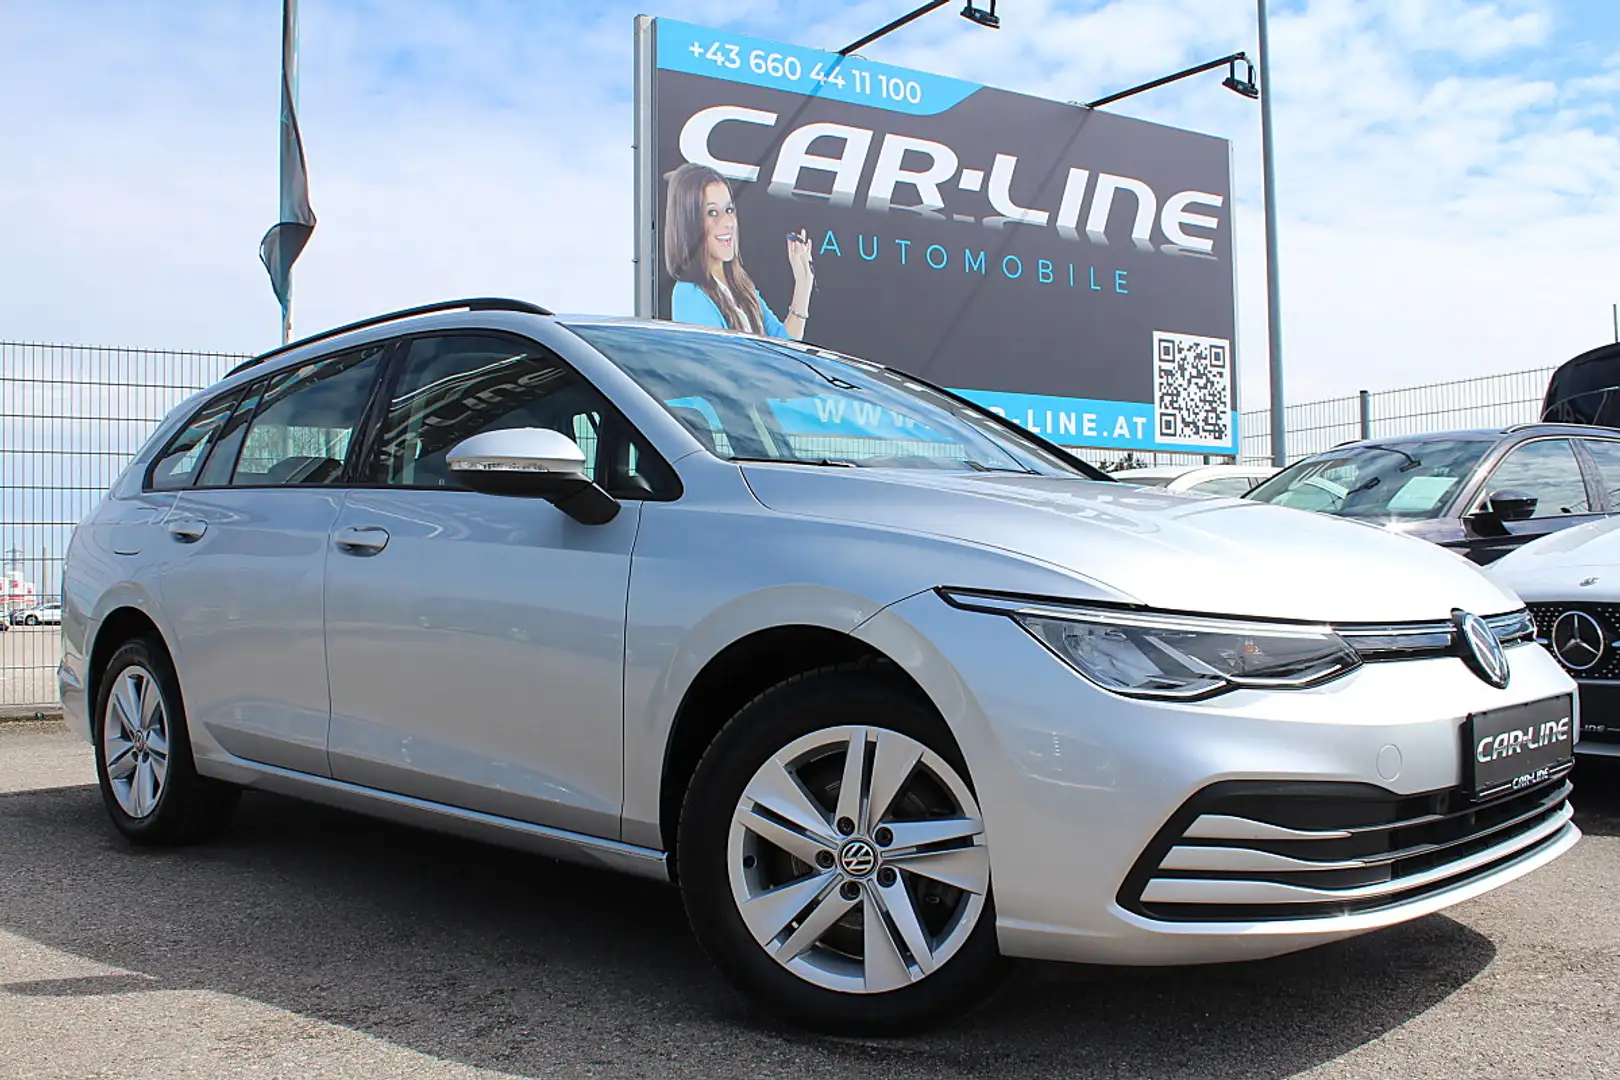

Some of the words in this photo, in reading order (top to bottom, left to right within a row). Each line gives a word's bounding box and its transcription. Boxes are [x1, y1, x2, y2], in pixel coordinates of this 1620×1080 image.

[689, 41, 741, 69] +43
[749, 50, 801, 80] 660
[810, 62, 846, 89] 44
[852, 69, 871, 95] 11
[877, 74, 922, 104] 100
[678, 105, 1224, 252] CAR-LINE
[820, 230, 1128, 294] AUTOMOBILE
[1477, 716, 1569, 762] CAR-LINE
